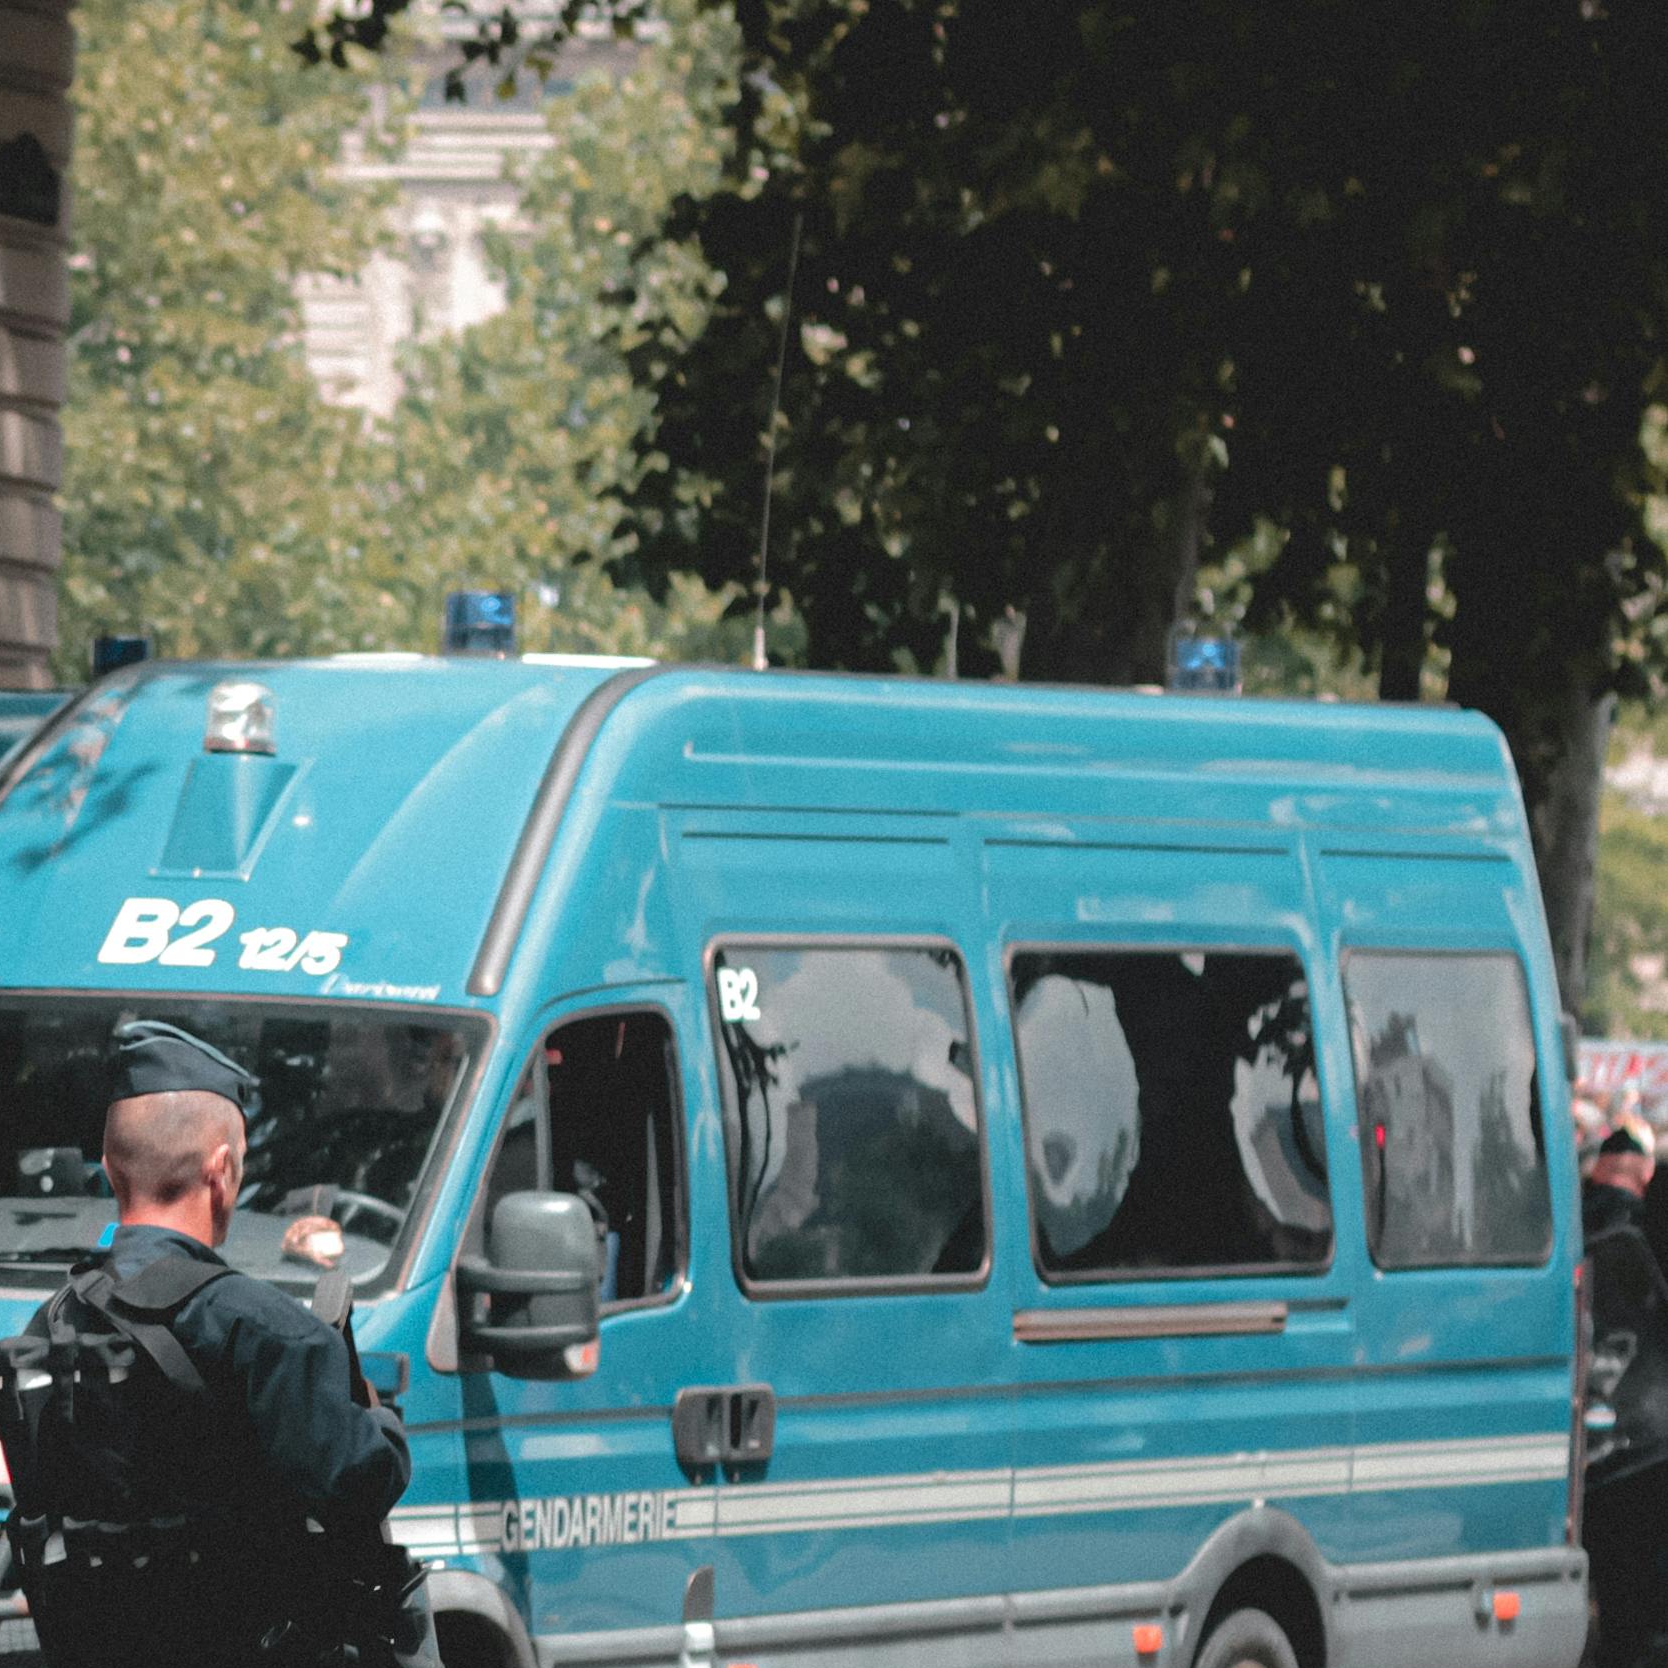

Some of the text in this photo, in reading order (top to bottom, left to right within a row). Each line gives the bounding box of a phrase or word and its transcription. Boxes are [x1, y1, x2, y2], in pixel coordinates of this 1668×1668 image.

[97, 897, 348, 976] B2 12/5
[717, 967, 761, 1021] B2
[502, 1490, 677, 1553] GENDARMERIE
